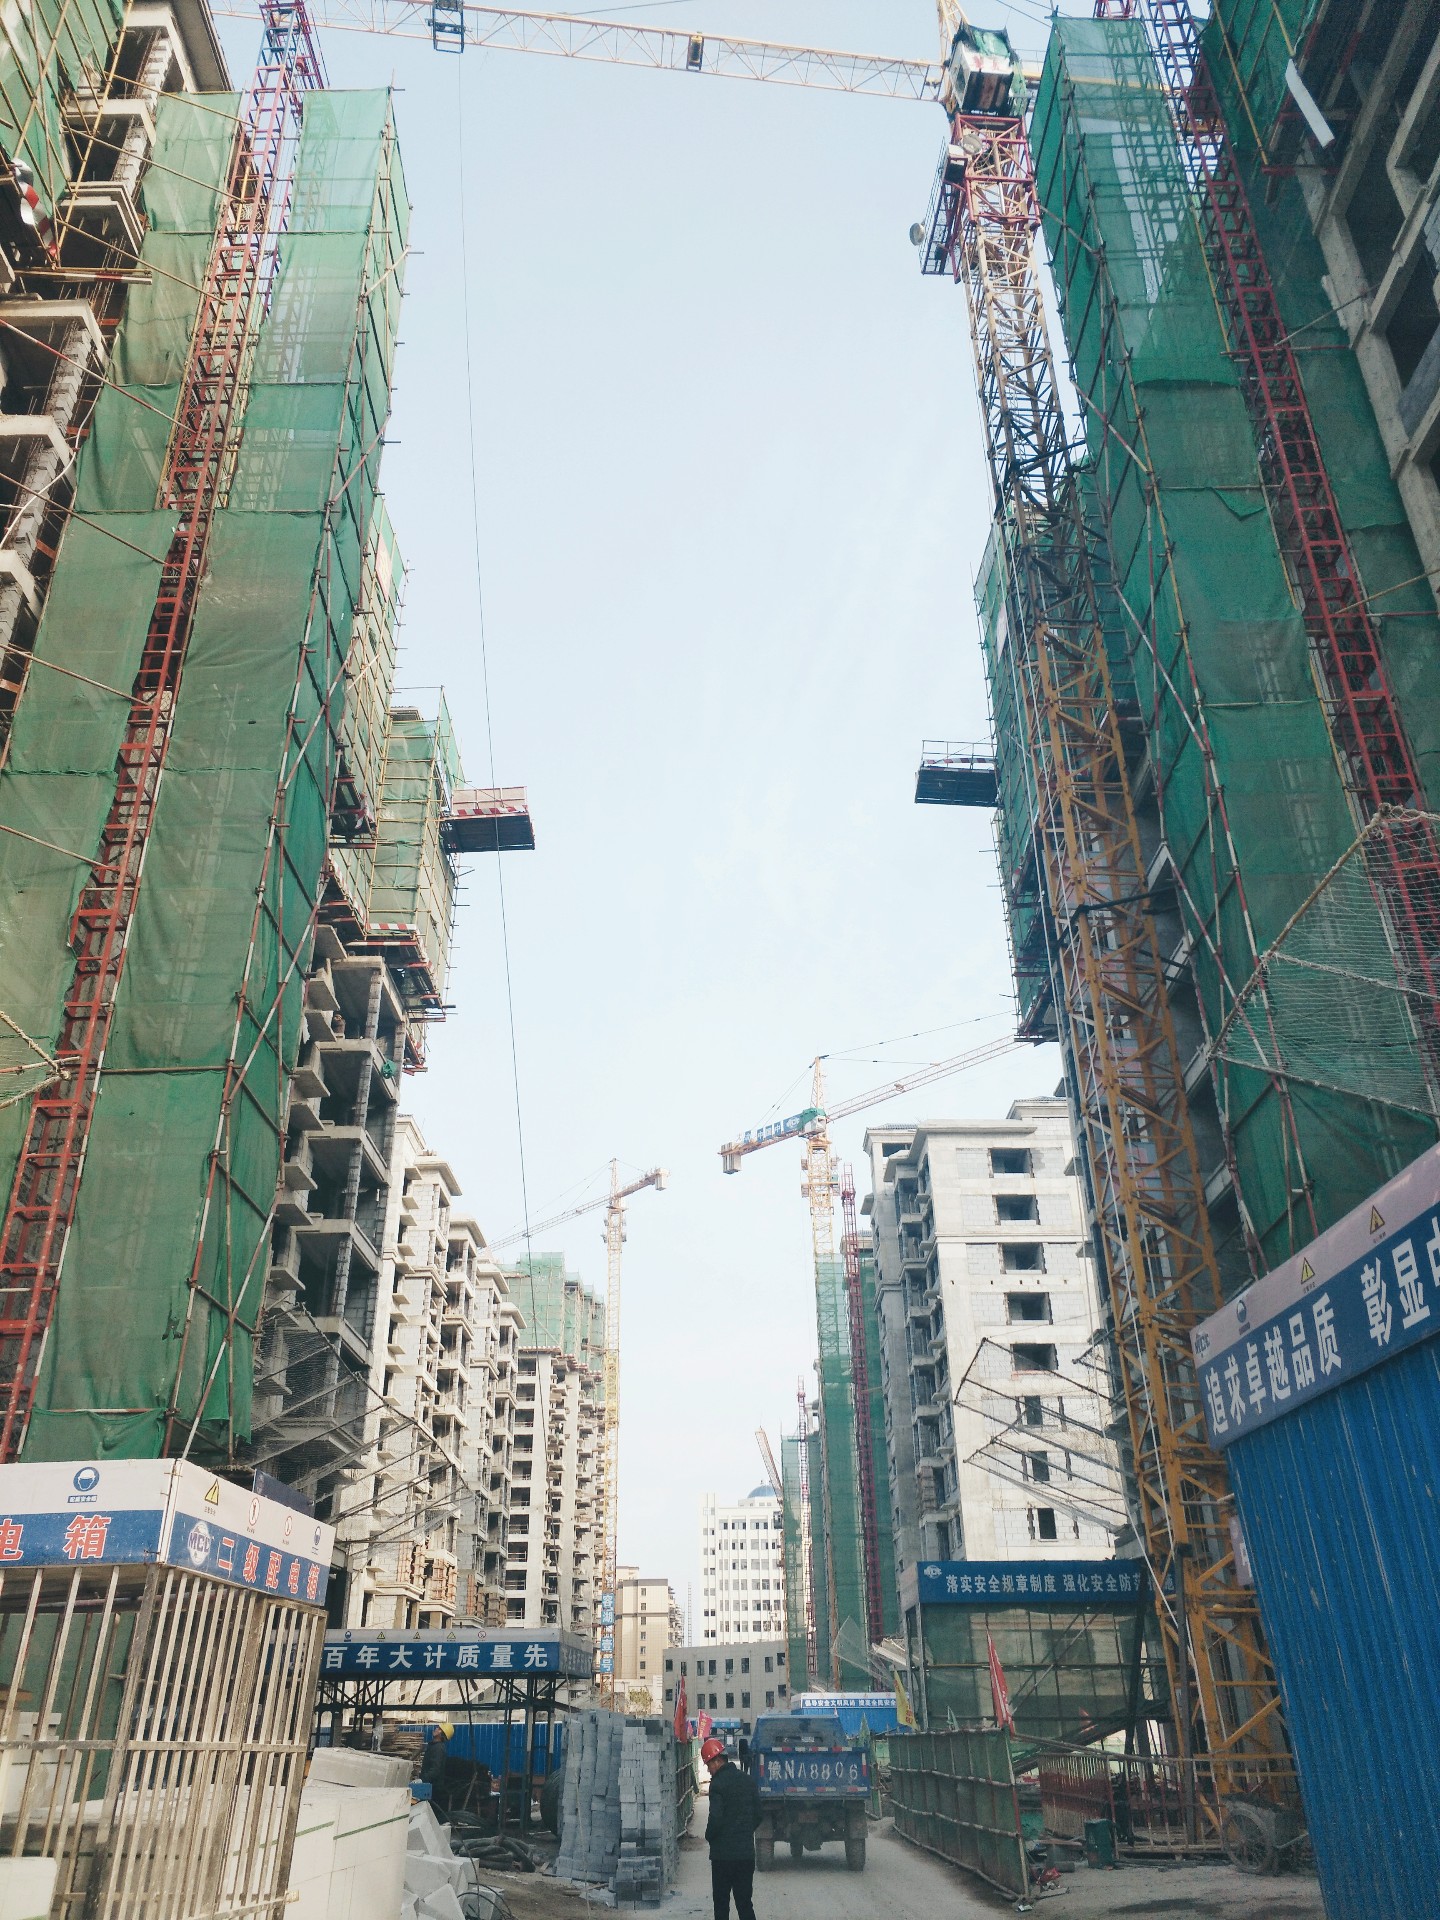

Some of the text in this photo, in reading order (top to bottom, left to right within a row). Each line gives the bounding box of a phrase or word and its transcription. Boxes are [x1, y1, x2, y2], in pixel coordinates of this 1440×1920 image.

[1205, 1292, 1342, 1435] 追求卓越品质
[217, 1536, 321, 1600] 二级配电箱
[945, 1574, 1057, 1594] 落实安全规章制度
[323, 1644, 548, 1669] 百年大计质量先
[767, 1759, 859, 1782] 豫NA8806
